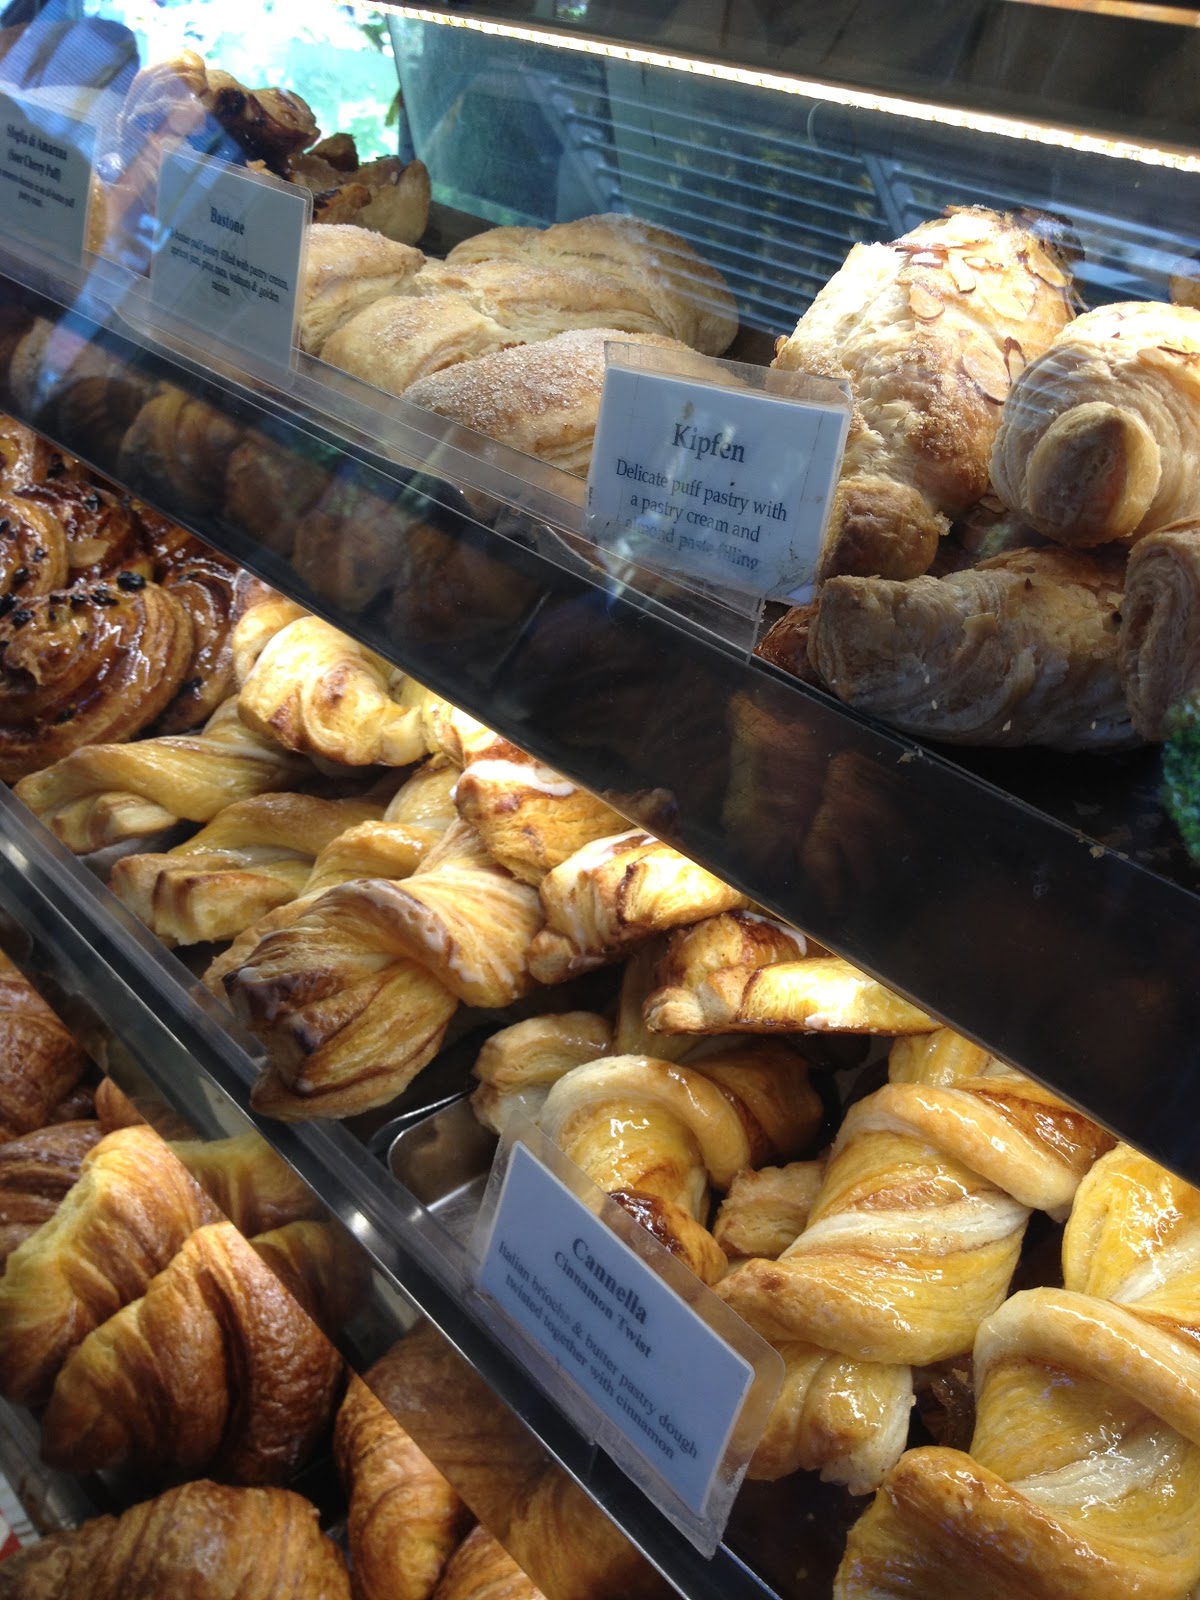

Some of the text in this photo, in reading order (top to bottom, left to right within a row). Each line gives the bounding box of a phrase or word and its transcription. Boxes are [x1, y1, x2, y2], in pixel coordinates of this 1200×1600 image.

[210, 206, 245, 236] Bastone
[672, 422, 746, 463] Kipfen
[615, 458, 788, 522] Delicate puff pastry with
[629, 494, 762, 543] a pastry cream and
[554, 1250, 653, 1359] Cinnamon Twist
[572, 1237, 648, 1326] Cannella
[498, 1240, 700, 1460] Italian brioche & butter pastry dough
[504, 1273, 675, 1462] twisted together with cinnamon
